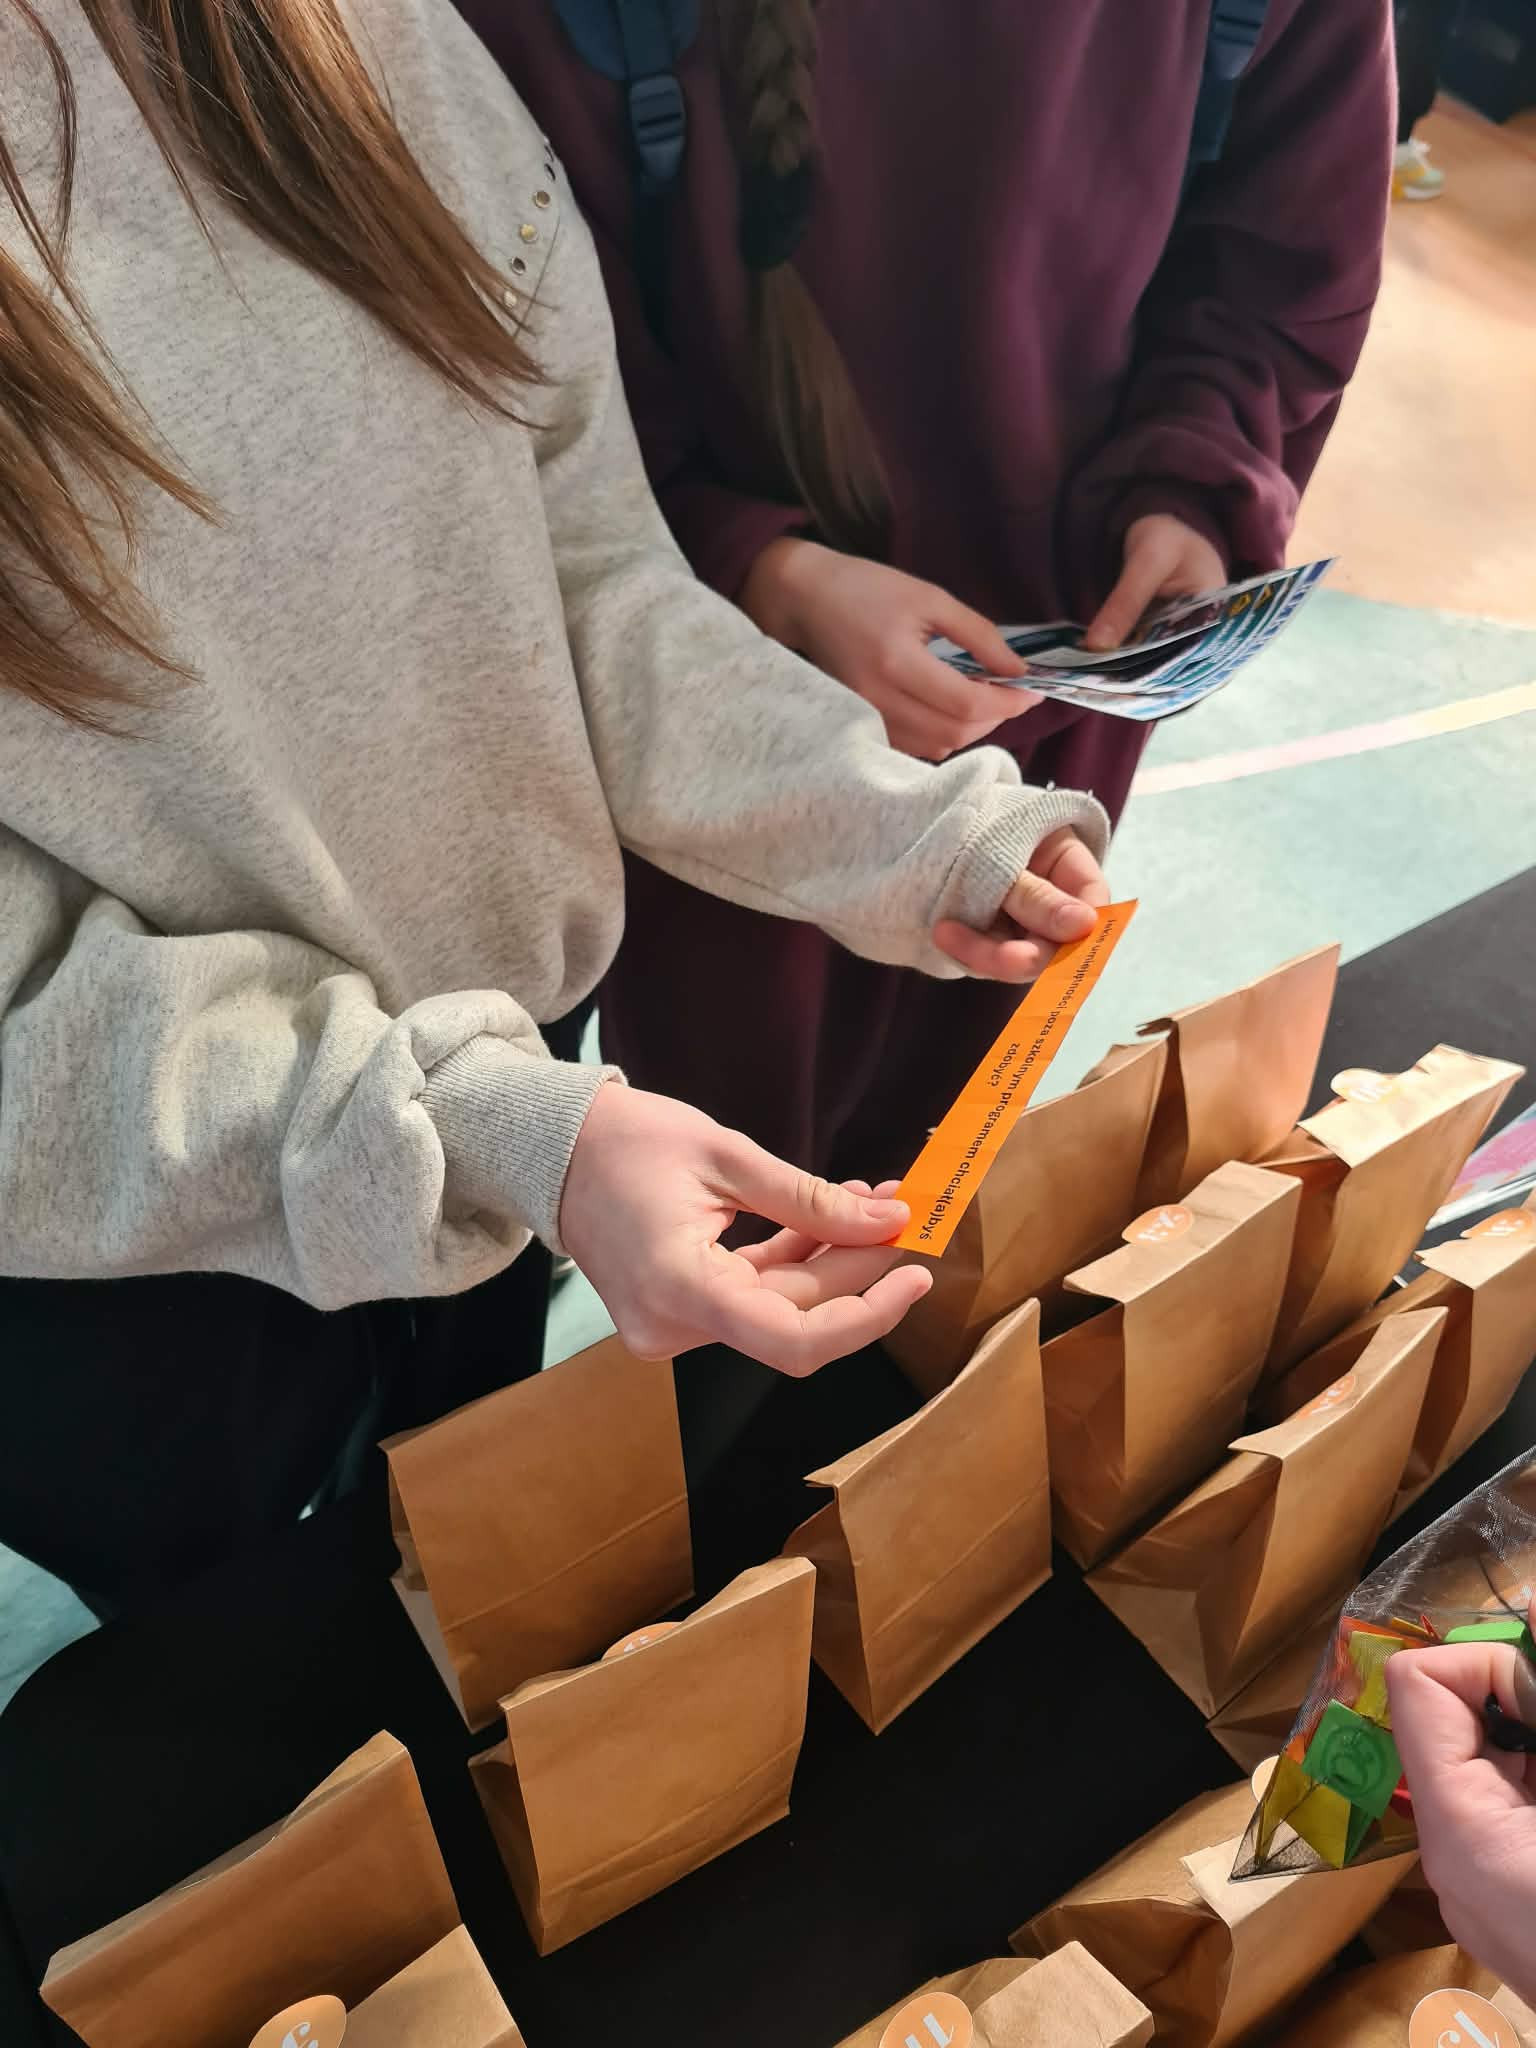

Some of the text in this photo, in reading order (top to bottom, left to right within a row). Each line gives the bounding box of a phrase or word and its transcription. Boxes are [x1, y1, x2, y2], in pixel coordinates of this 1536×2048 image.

[1040, 1011, 1061, 1036] poza
[987, 1043, 1020, 1087] zdobyć?
[1008, 1038, 1045, 1090] szkolnym
[965, 1092, 1013, 1159] programem
[919, 1161, 971, 1241] chciał(a)byś
